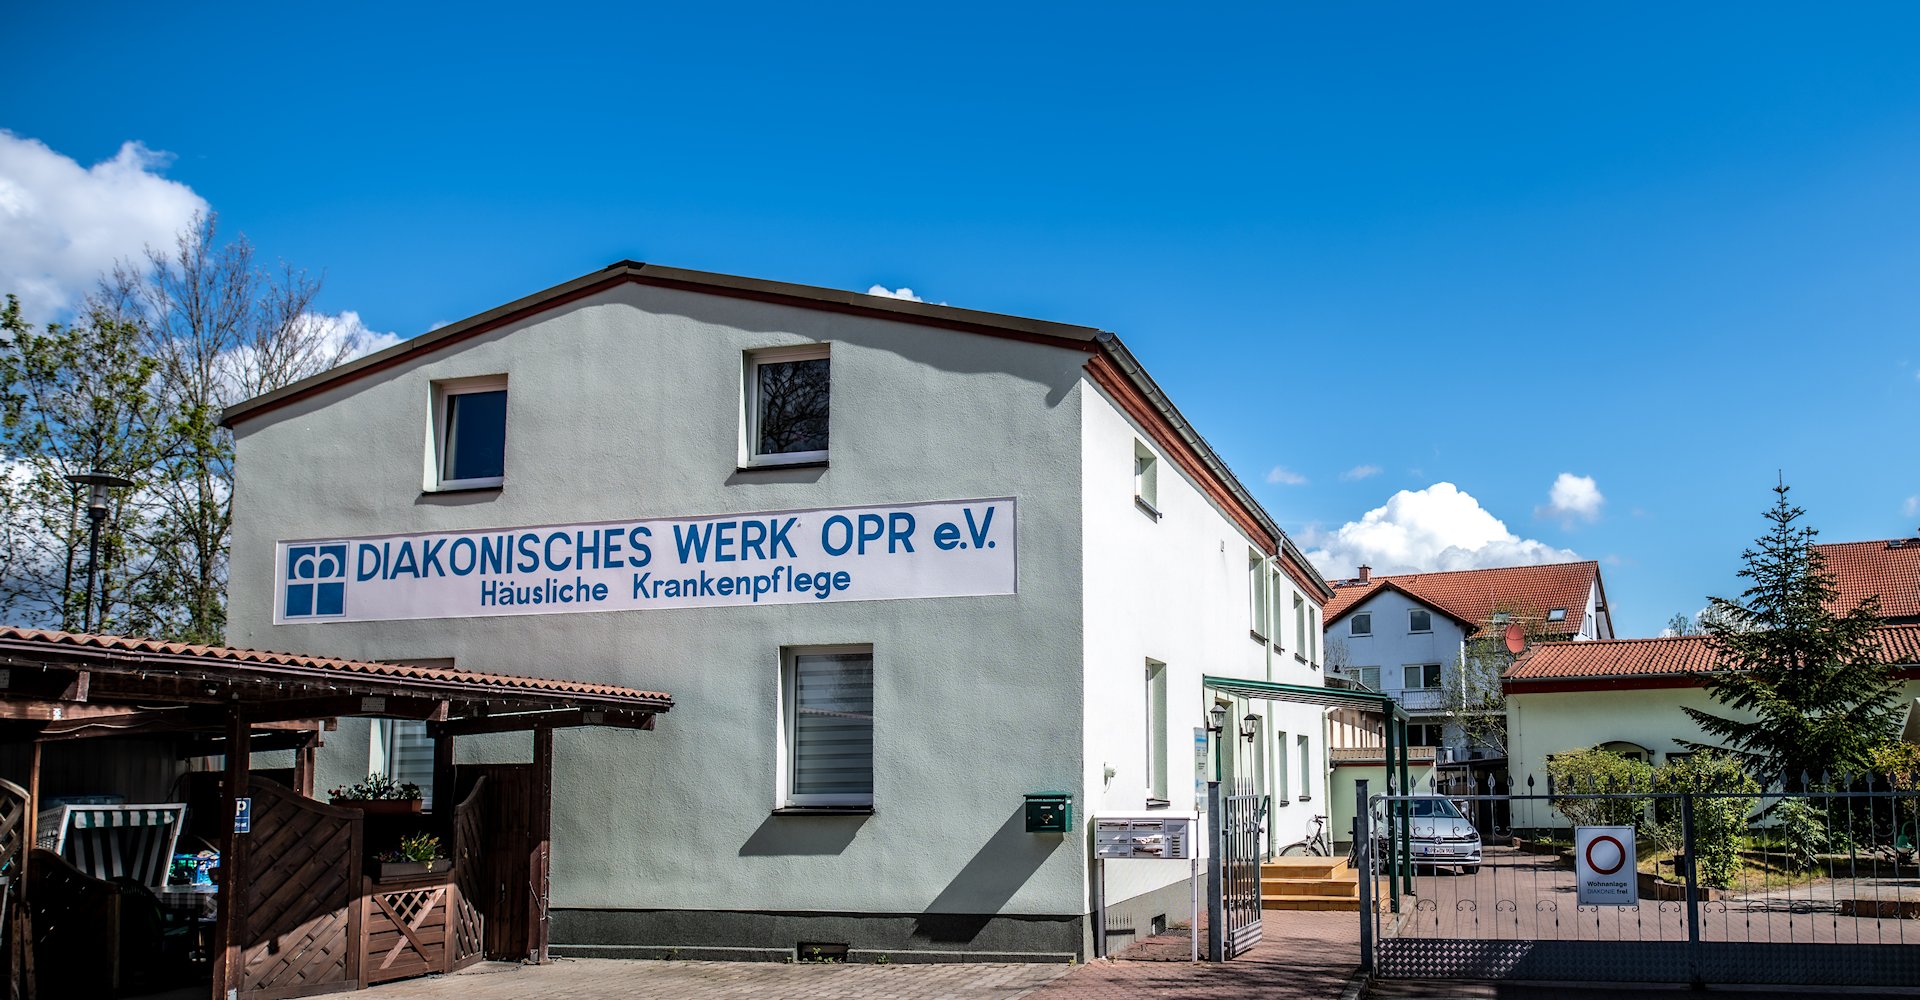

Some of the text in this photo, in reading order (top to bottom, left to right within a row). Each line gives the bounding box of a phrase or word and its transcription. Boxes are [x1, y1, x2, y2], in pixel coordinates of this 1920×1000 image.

[356, 506, 996, 582] DIAKONISCHES WERK OPR e.V.
[480, 565, 851, 606] Häusliche Krankenpflege
[236, 800, 247, 816] P
